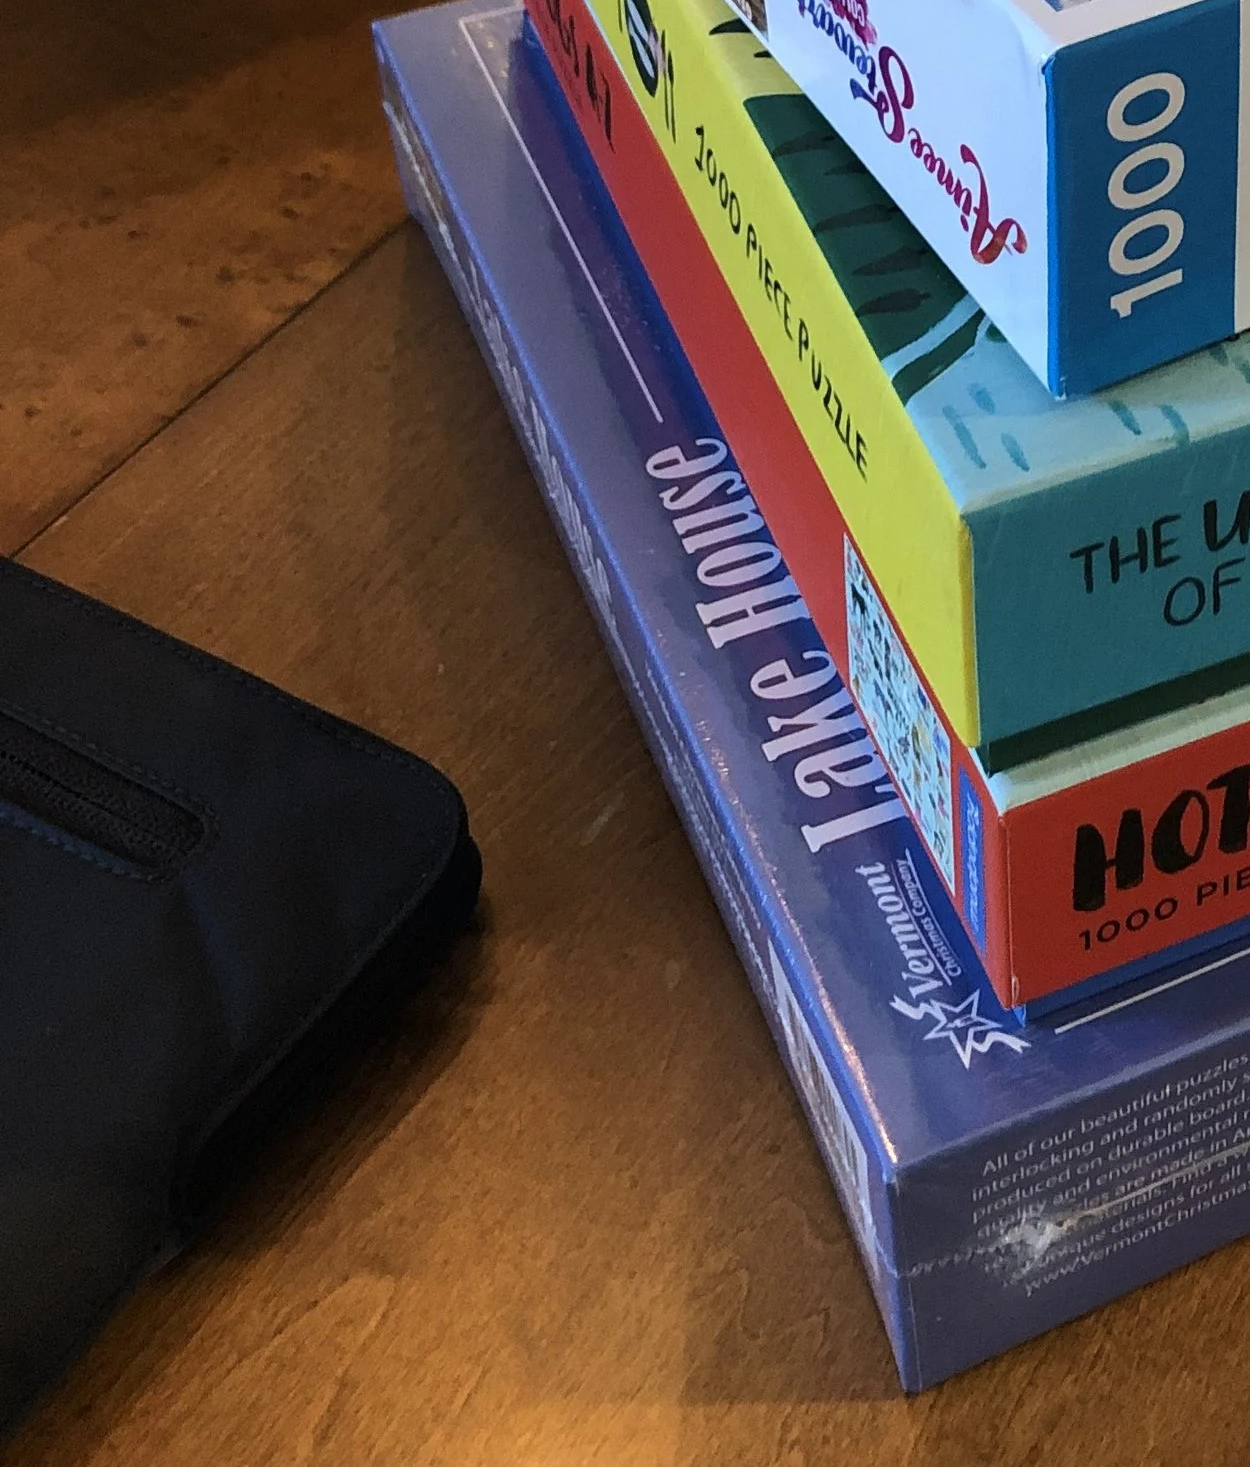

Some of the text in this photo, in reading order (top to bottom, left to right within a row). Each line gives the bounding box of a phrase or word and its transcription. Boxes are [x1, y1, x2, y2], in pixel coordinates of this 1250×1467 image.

[909, 128, 1028, 265] Aimee
[1106, 71, 1186, 319] 1000
[694, 125, 869, 482] 1000 PIECE PUZZLE
[646, 437, 814, 649] House
[1069, 514, 1182, 595] THE
[1162, 568, 1245, 627] OF
[749, 650, 906, 853] Lake
[854, 861, 943, 999] Vermont
[896, 858, 962, 976] Christmas Company
[1077, 895, 1181, 952] 1000
[970, 1137, 1095, 1204] interlocking
[1099, 1116, 1138, 1146] and
[1143, 1075, 1237, 1129] randomly
[971, 1165, 1071, 1225] produced
[1075, 1155, 1102, 1175] on
[1107, 1117, 1184, 1161] durable
[980, 1152, 1008, 1177] All
[1013, 1140, 1034, 1163] of
[1039, 1128, 1074, 1151] our
[1079, 1081, 1171, 1134] beautiful
[1175, 1050, 1249, 1096] puzzles
[1051, 1175, 1090, 1205] and
[1095, 1110, 1238, 1186] environmental
